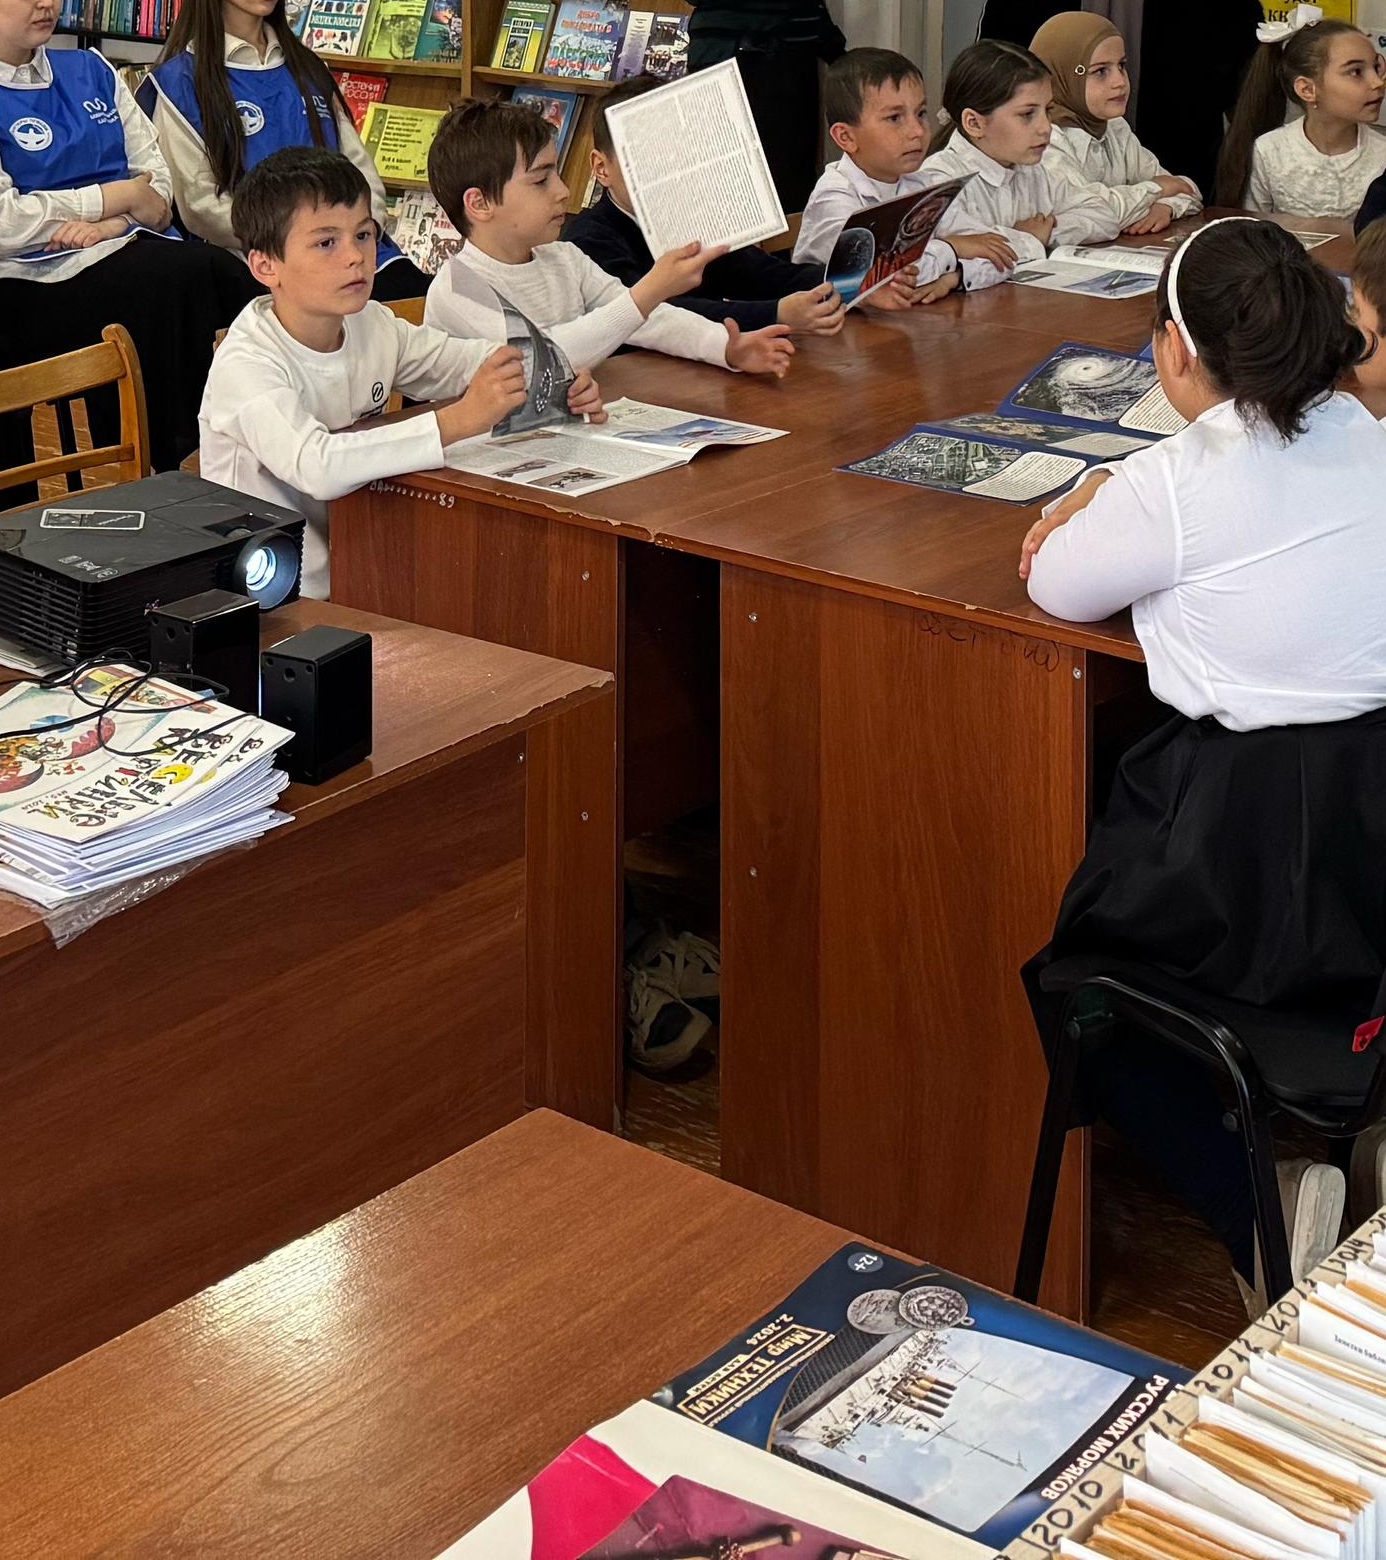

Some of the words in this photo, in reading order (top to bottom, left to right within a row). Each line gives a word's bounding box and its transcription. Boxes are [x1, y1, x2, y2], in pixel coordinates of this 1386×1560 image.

[854, 1253, 880, 1272] 12+
[747, 1313, 793, 1347] 2.2024
[766, 1329, 813, 1358] Мир
[690, 1356, 775, 1416] ТЕХНИКИ
[1110, 1374, 1171, 1442] РУССКИХ
[1041, 1438, 1115, 1501] МОРЯКОВ
[1032, 1479, 1104, 1546] 2010
